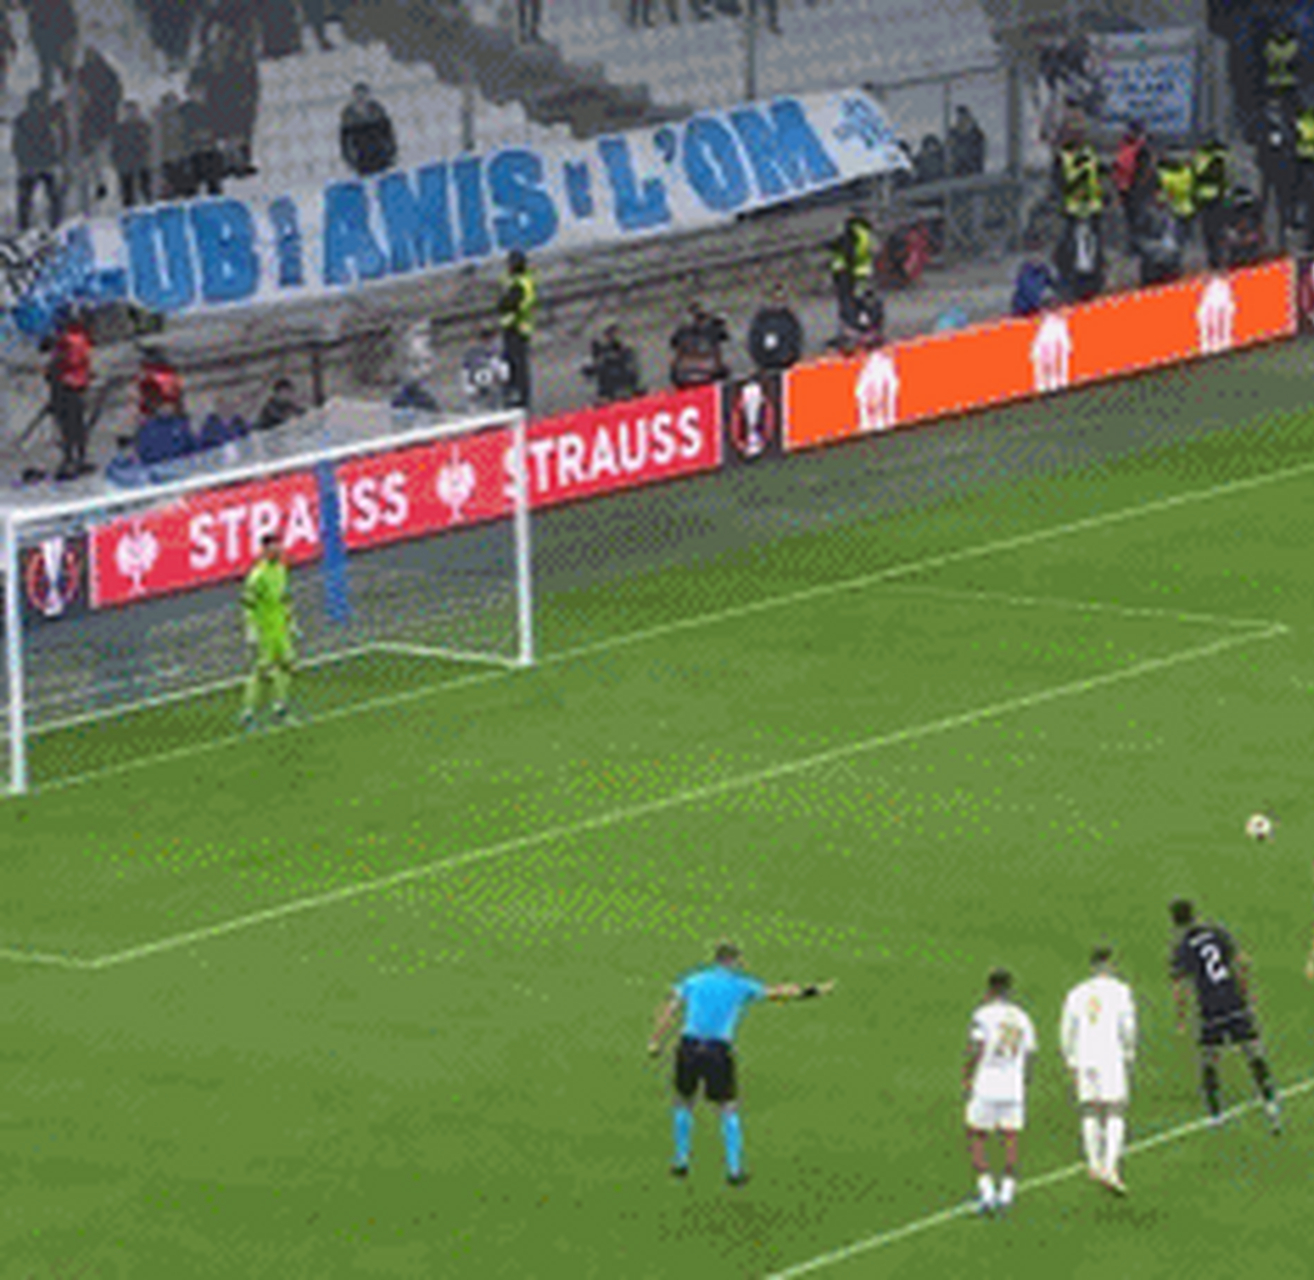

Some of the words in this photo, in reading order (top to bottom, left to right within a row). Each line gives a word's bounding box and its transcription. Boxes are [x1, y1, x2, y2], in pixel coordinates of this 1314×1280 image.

[323, 149, 559, 286] AMIS
[597, 97, 840, 231] L'OM
[188, 470, 409, 569] STRASS
[1199, 943, 1229, 983] 2
